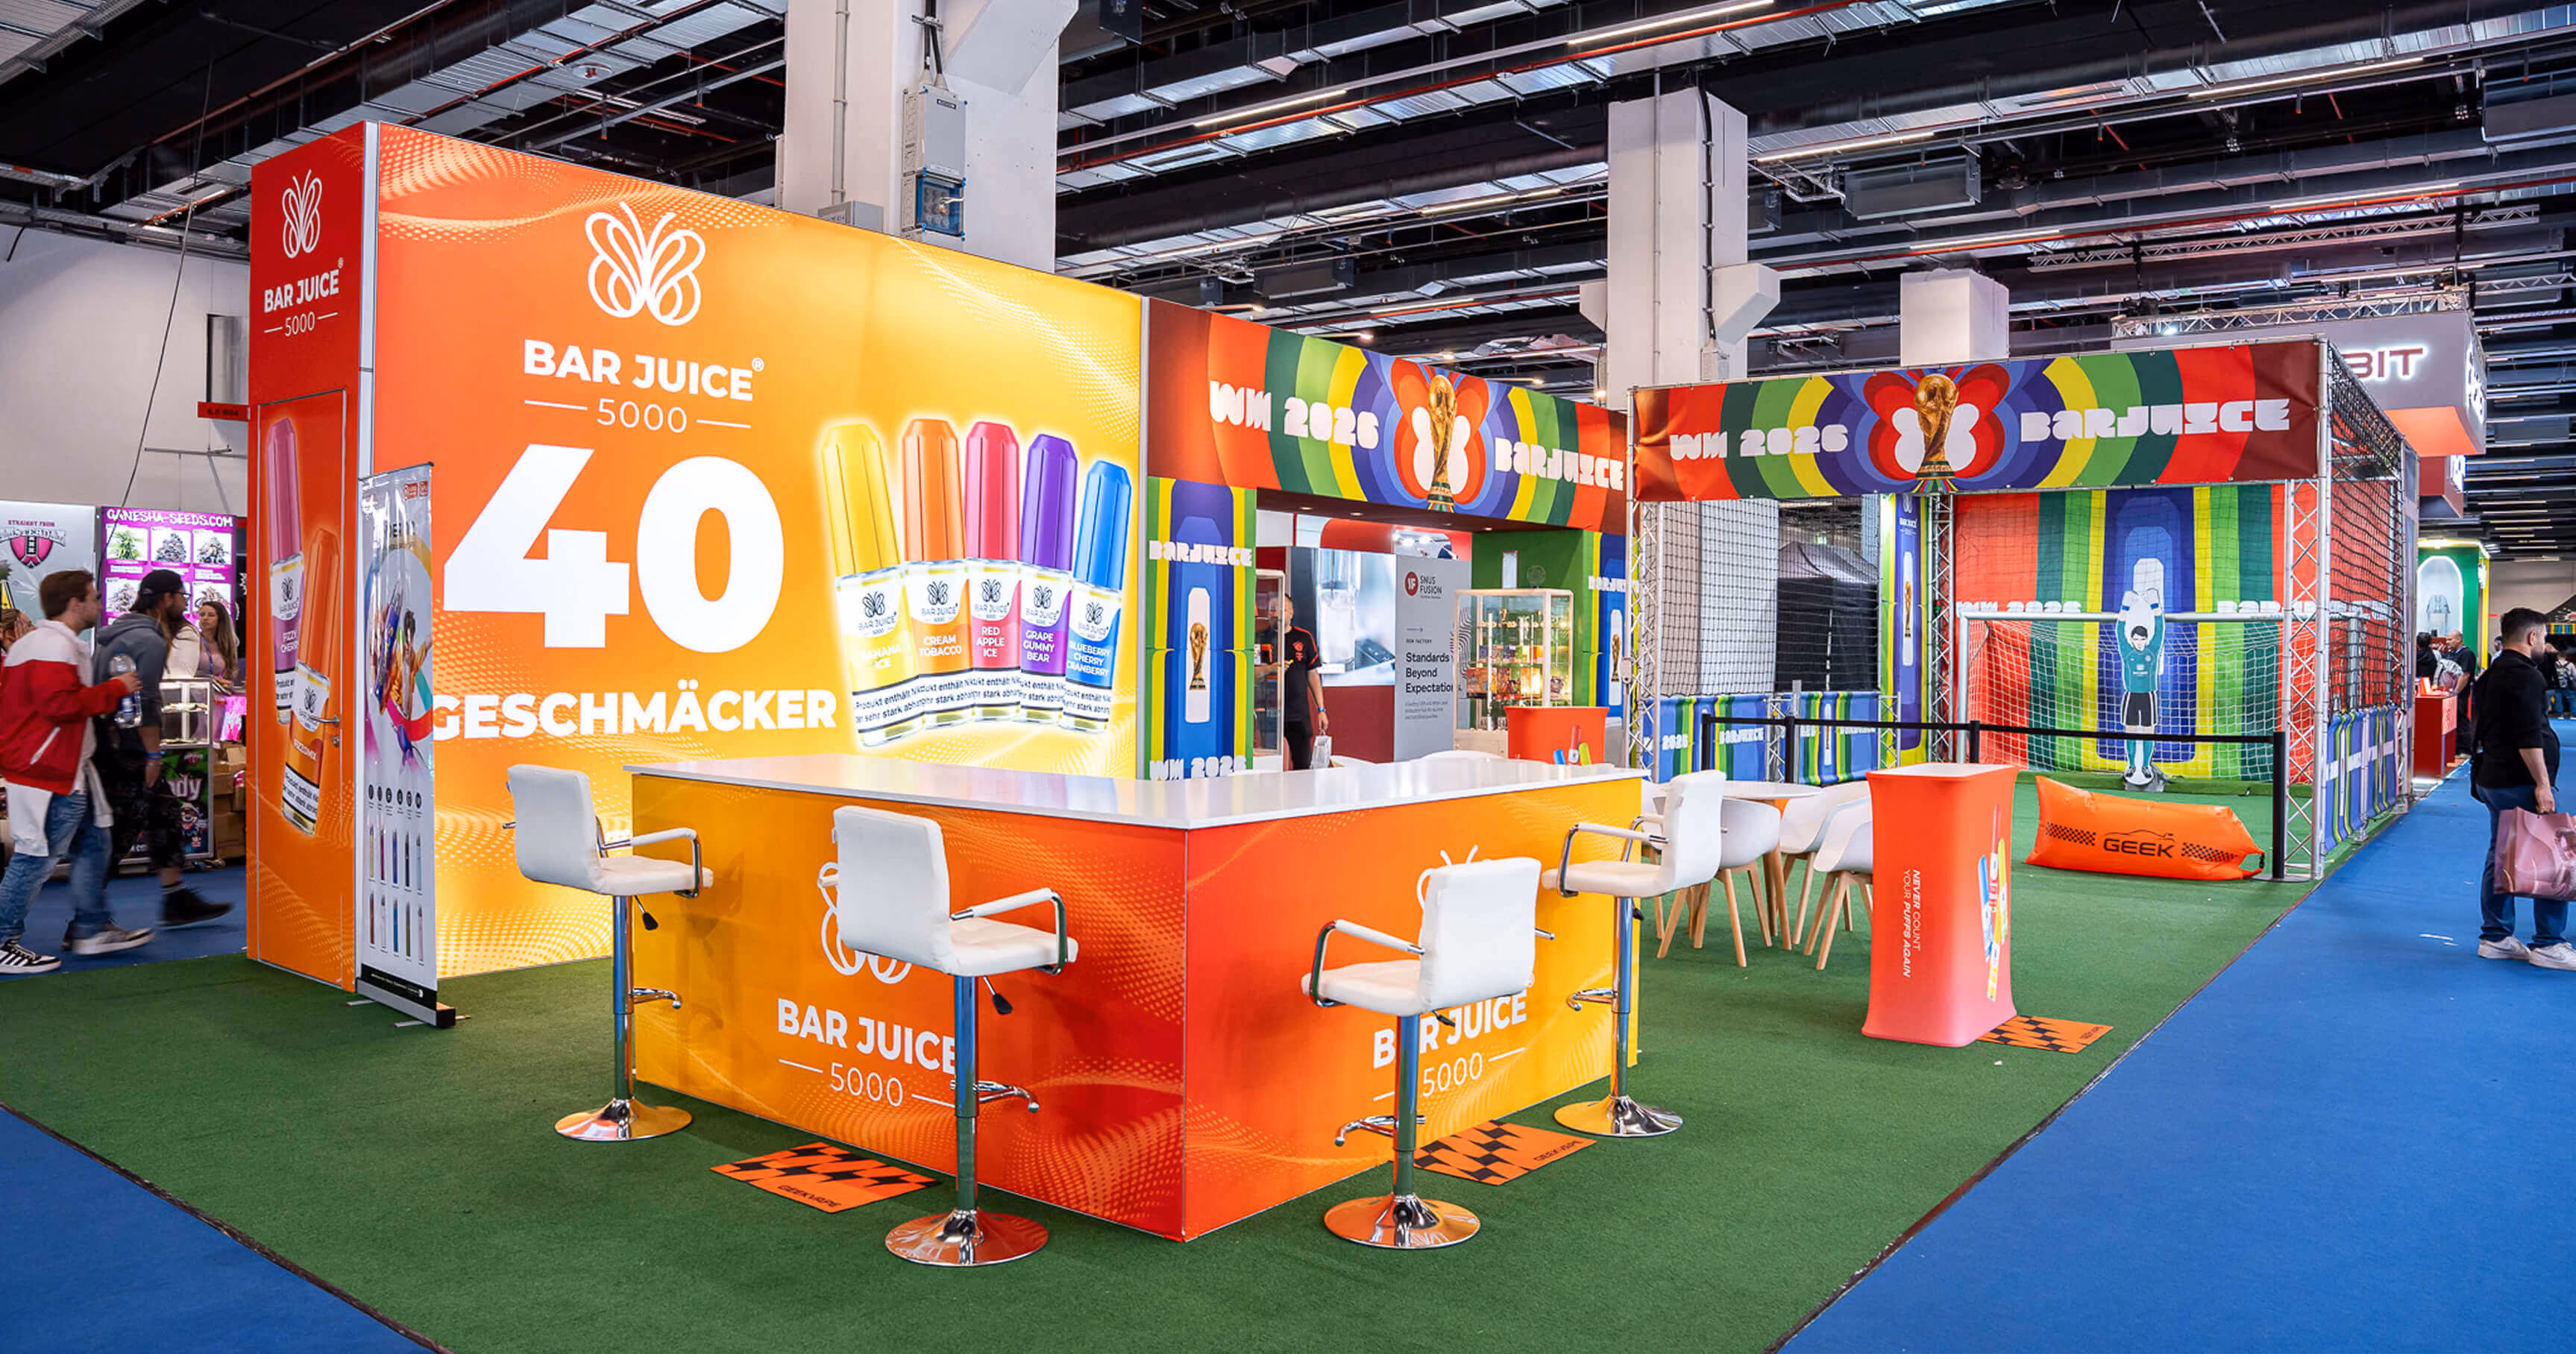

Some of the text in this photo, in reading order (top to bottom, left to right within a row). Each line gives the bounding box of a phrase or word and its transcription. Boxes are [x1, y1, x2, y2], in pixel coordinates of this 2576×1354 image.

[264, 285, 293, 312] BAR
[285, 312, 315, 338] 5000
[524, 339, 621, 384] BAR
[597, 398, 687, 433] 5000
[1740, 423, 1848, 457] 2026
[2020, 398, 2290, 442] BARJUICE
[1284, 397, 1380, 449] 2026
[1495, 438, 1624, 491] BARJUICE
[107, 508, 233, 527] GANESHA-SEEDS.COM
[443, 444, 785, 653] 40
[1420, 575, 1436, 585] SNUS
[1420, 585, 1442, 594] FUSION
[923, 635, 956, 645] CREAM
[981, 626, 1000, 635] RED
[1025, 630, 1054, 642] GRAPE
[919, 646, 962, 656] TOBACCO
[976, 637, 1005, 646] APPLE
[1023, 640, 1055, 652] GUMMY
[874, 658, 891, 668] ICE
[983, 649, 998, 657] ICE
[1026, 652, 1050, 662] BEAR
[1073, 652, 1105, 666] CHERRY
[1406, 652, 1450, 663] Standards
[1406, 667, 1437, 679] Beyond
[433, 678, 838, 741] GESCHMÄCKER
[2103, 838, 2174, 858] GEEK
[1903, 901, 1911, 939] PUFFS
[1912, 869, 1920, 951] NEVER COUNT
[1903, 939, 1911, 978] AGAIN
[777, 997, 955, 1074] BAR JUICE
[1374, 989, 1527, 1069] BR JUICE
[829, 1062, 904, 1107] 5000
[1422, 1052, 1483, 1097] 5000
